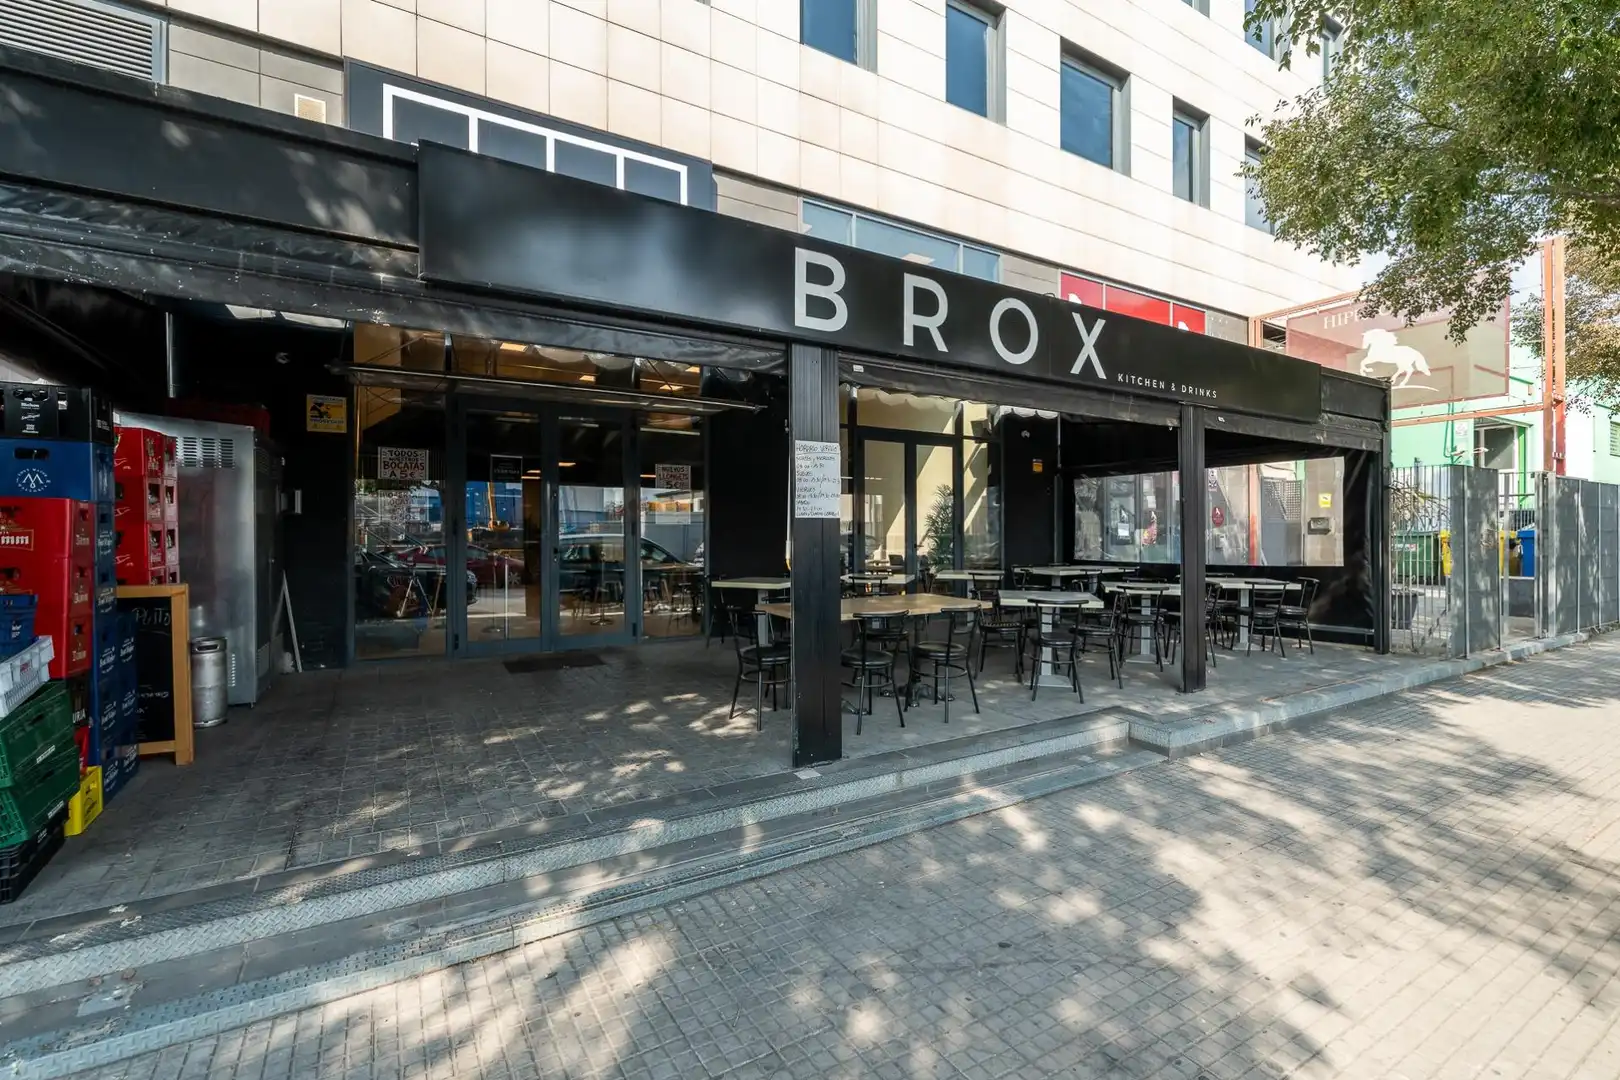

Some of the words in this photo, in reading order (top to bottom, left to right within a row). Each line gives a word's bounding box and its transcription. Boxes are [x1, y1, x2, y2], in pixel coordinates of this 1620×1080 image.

[794, 246, 1107, 380] BROX
[1117, 373, 1166, 390] KITCHEN
[1170, 382, 1177, 391] &
[1181, 384, 1218, 399] DRINKS
[388, 449, 418, 457] TODOS
[383, 461, 425, 470] BOCATAS
[389, 470, 397, 478] A
